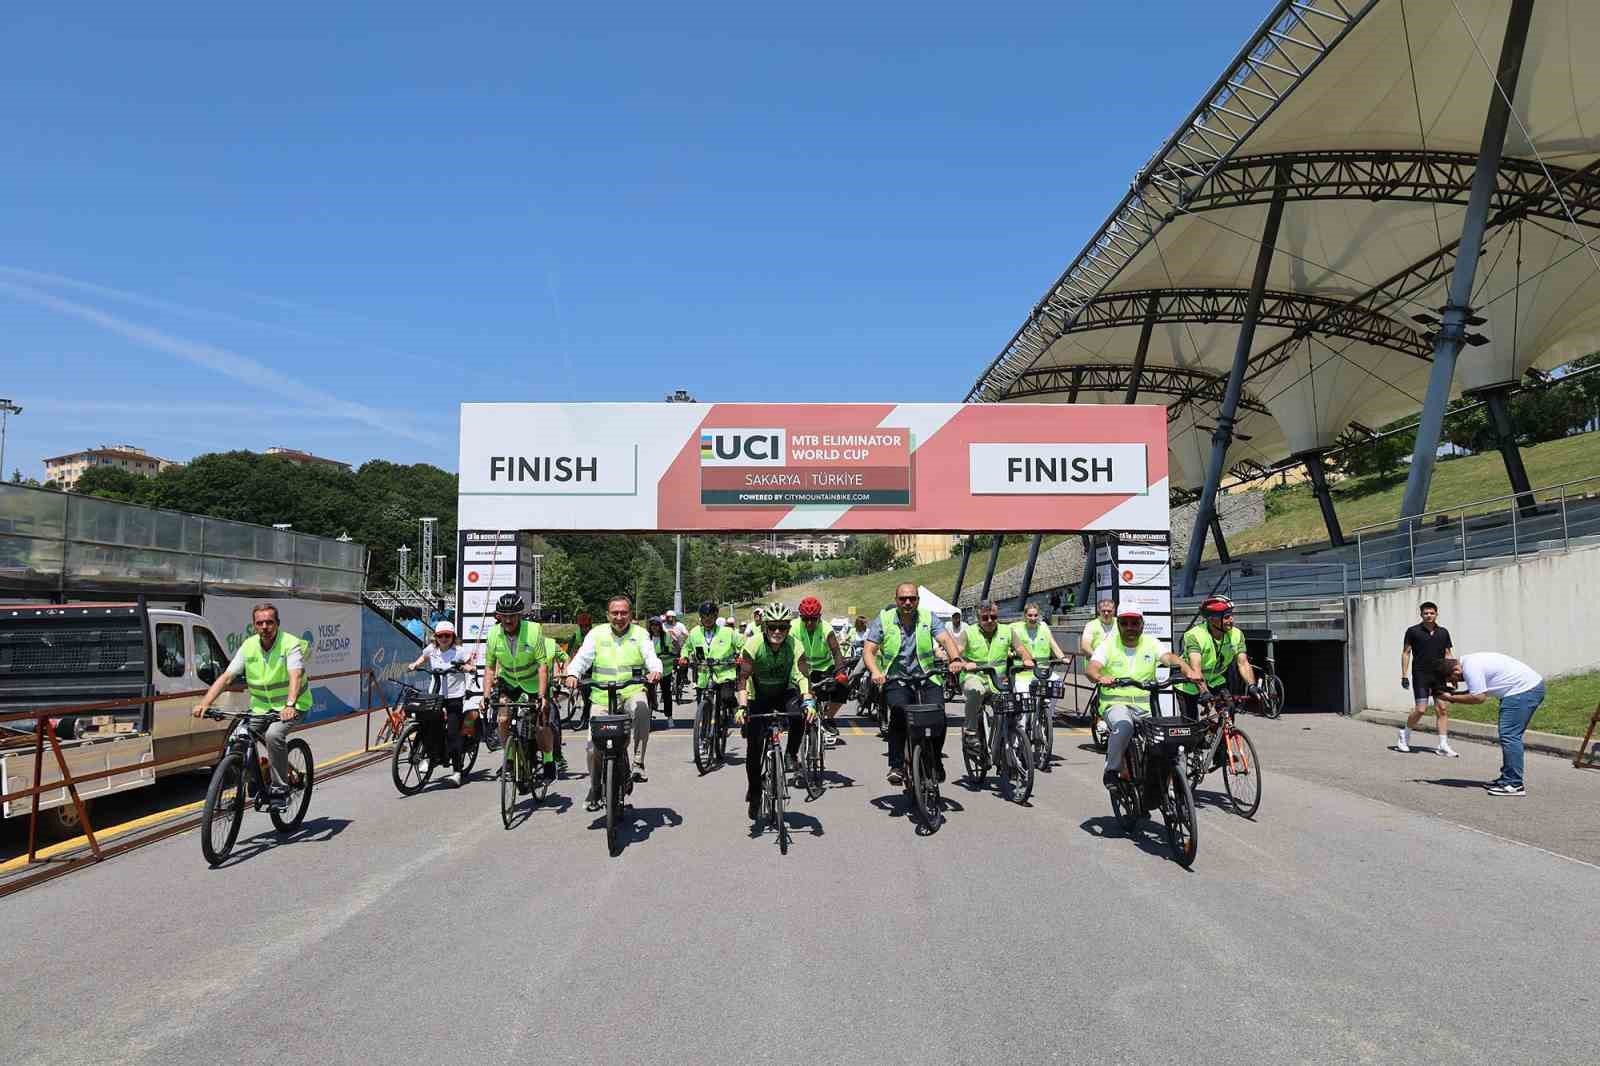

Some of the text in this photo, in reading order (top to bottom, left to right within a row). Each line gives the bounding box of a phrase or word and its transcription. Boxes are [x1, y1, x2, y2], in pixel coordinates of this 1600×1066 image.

[715, 435, 779, 459] UCI
[792, 435, 902, 446] MTB ELIMINATOR
[792, 449, 869, 460] WORLD CUP
[490, 456, 597, 482] FINISH
[1007, 457, 1113, 482] FINISH
[744, 474, 800, 486] SAKARYA
